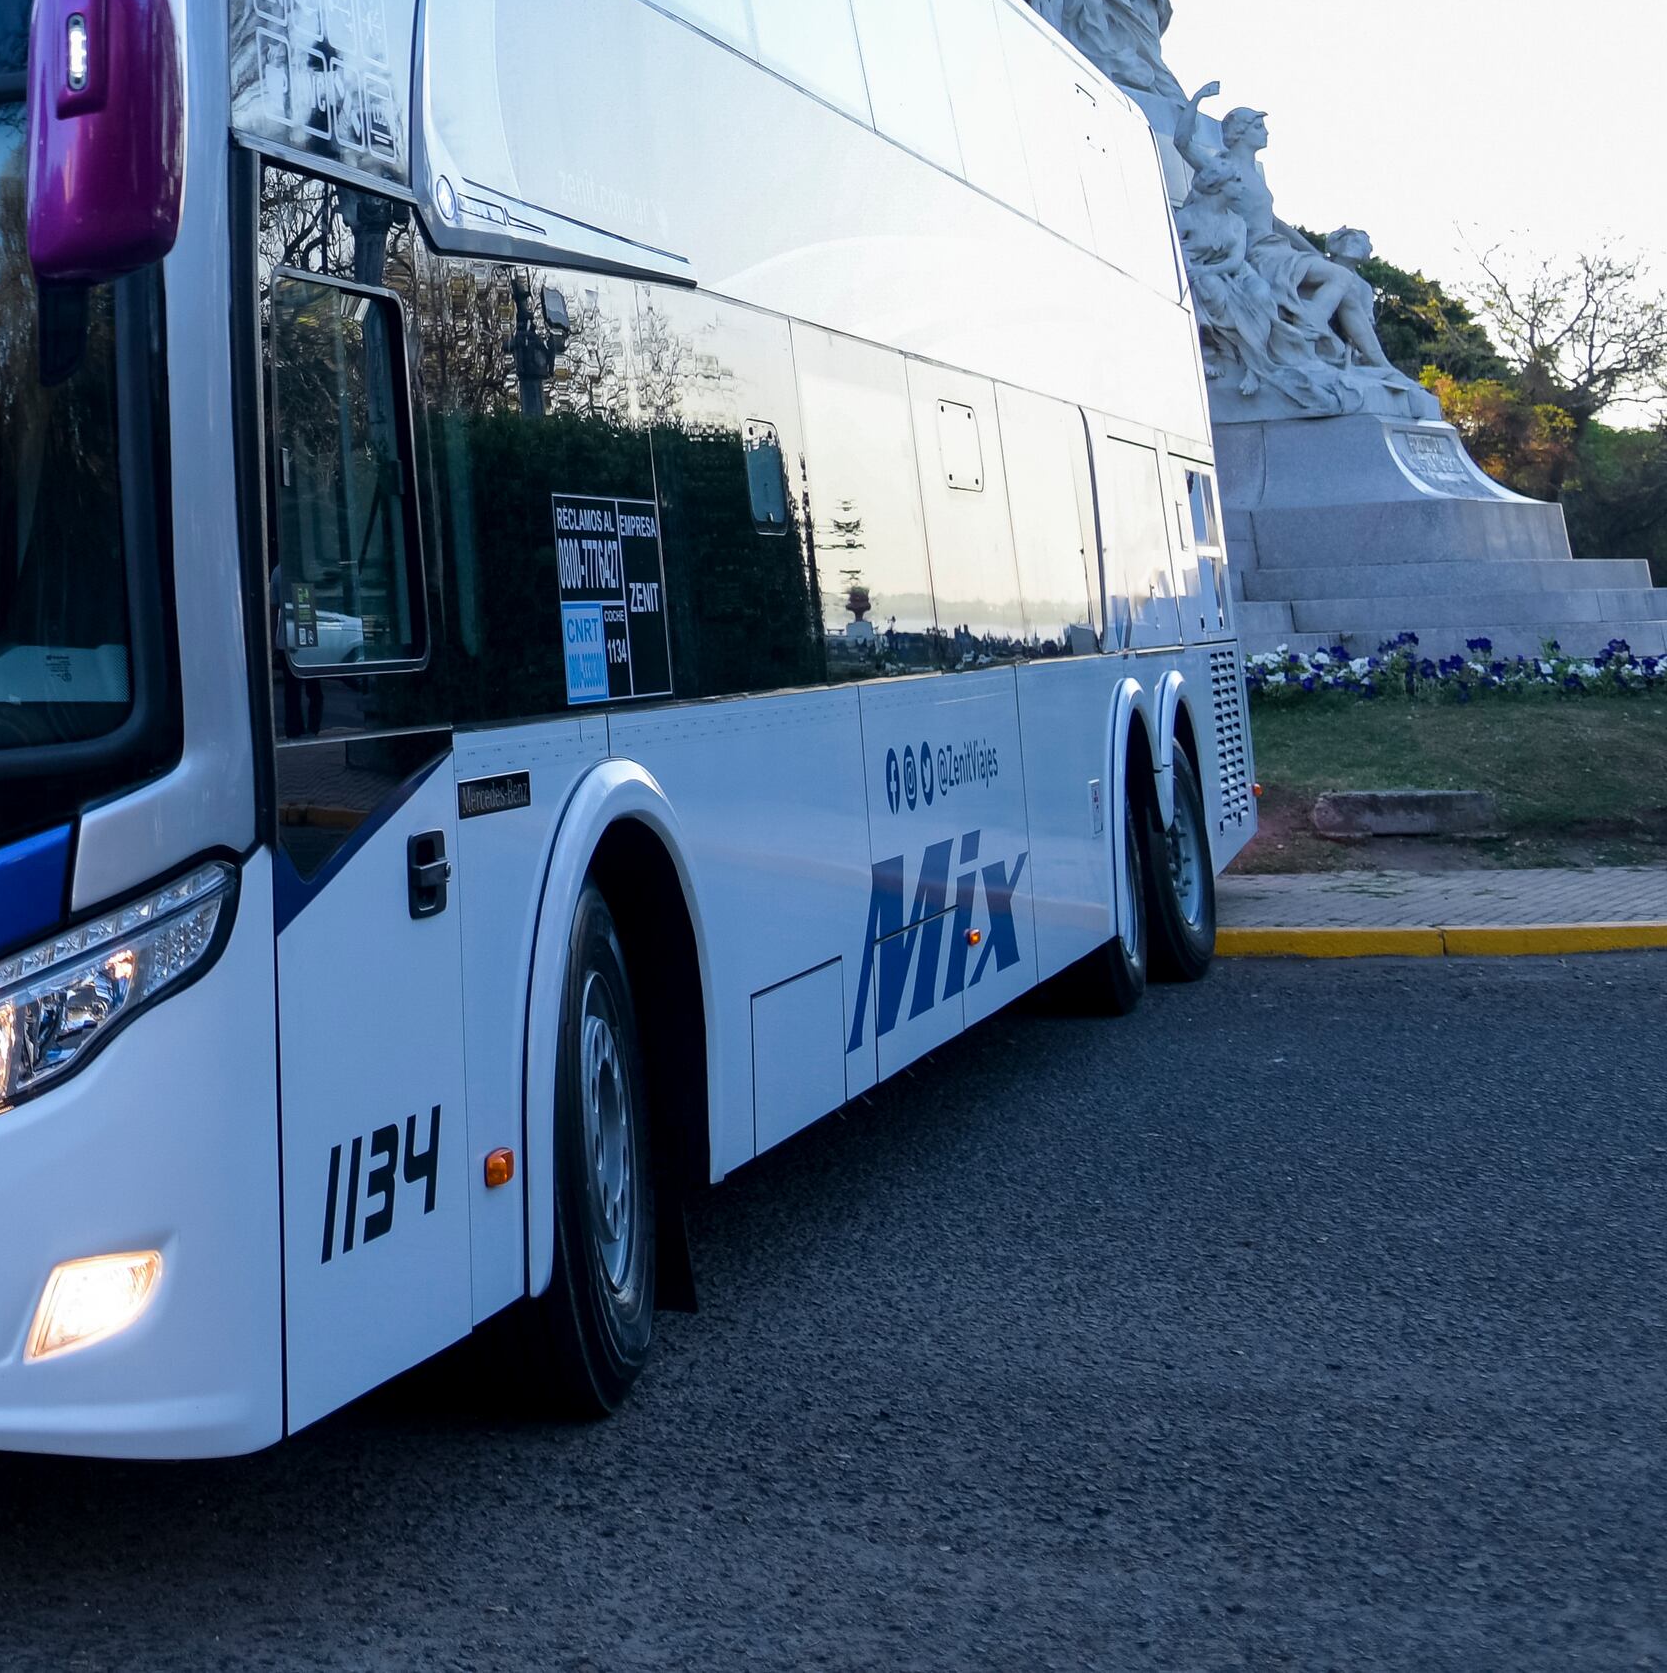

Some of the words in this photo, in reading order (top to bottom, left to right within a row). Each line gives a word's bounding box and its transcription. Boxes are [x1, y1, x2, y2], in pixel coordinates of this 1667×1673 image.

[556, 507, 603, 531] RECLAMOS
[604, 511, 615, 532] AL
[620, 515, 657, 537] EMPRESA
[629, 582, 659, 612] ZENIT
[604, 610, 625, 622] COCHE
[567, 618, 599, 643] CNRT
[608, 639, 627, 664] 1134
[937, 738, 999, 797] @ZenitViajes
[462, 778, 529, 813] Mercedes-Benz
[846, 829, 1029, 1054] Mix
[321, 1104, 441, 1265] 1134
